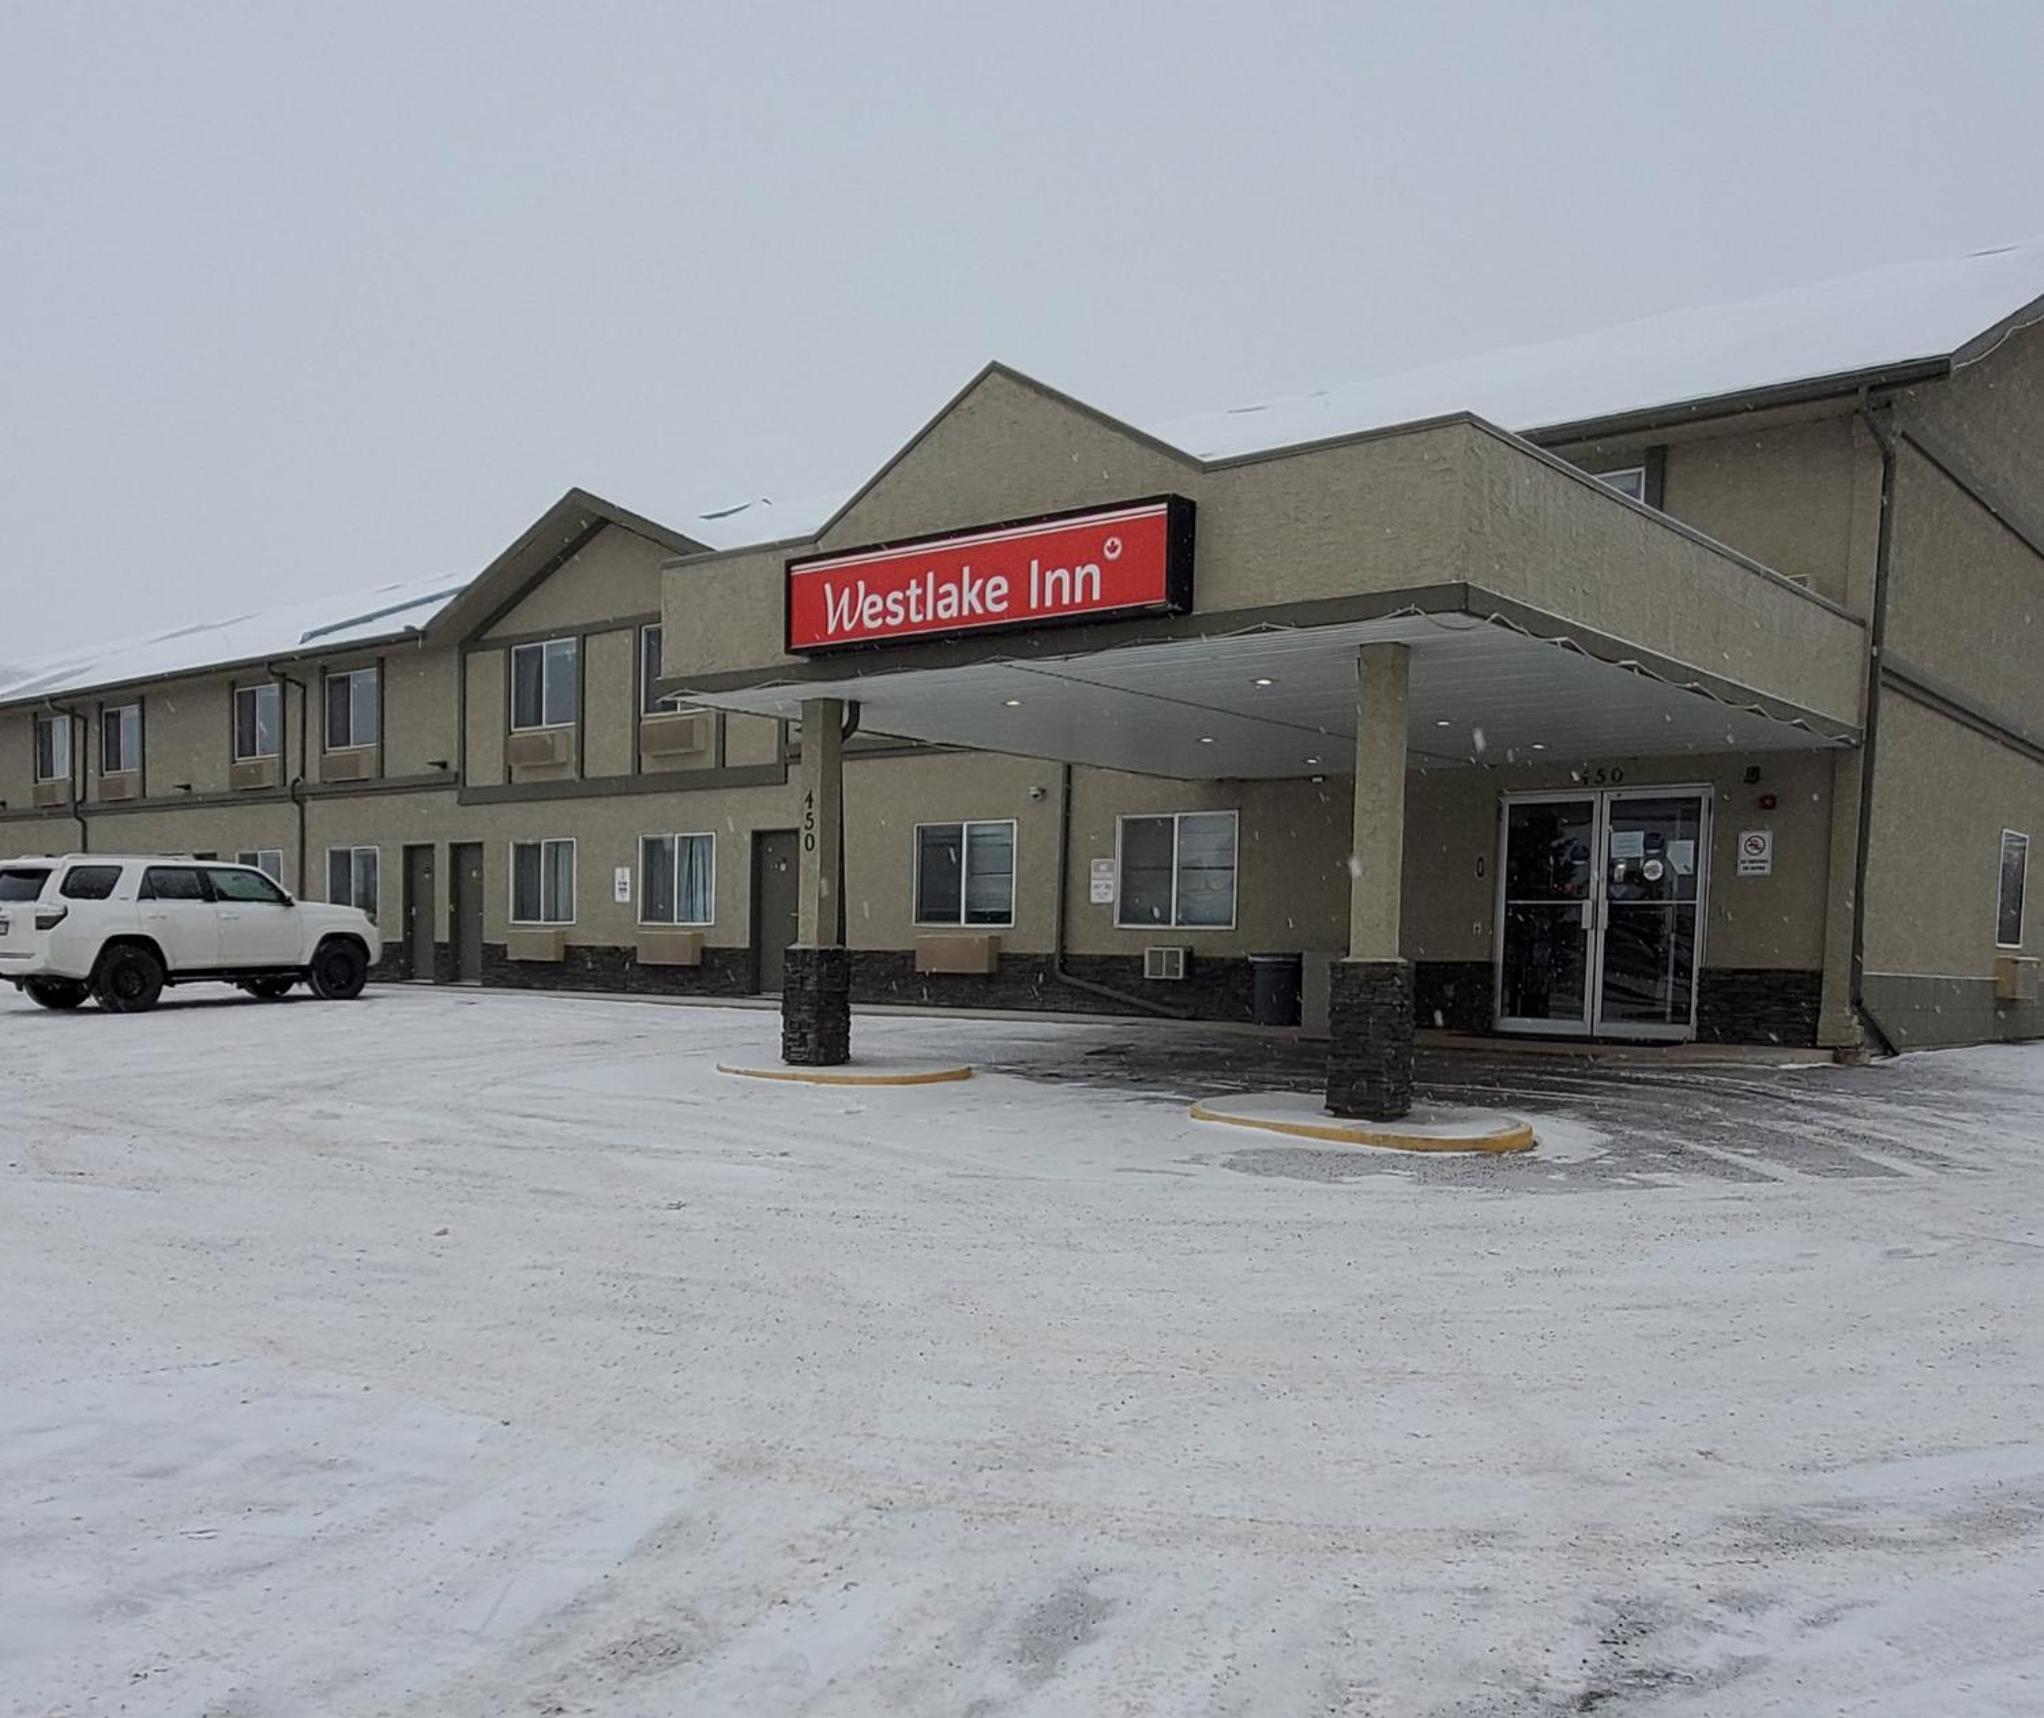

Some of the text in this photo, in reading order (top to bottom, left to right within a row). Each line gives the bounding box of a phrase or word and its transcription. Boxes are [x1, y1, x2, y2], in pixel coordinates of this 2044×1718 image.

[824, 559, 1101, 635] Westlake Inn
[804, 788, 816, 852] 450
